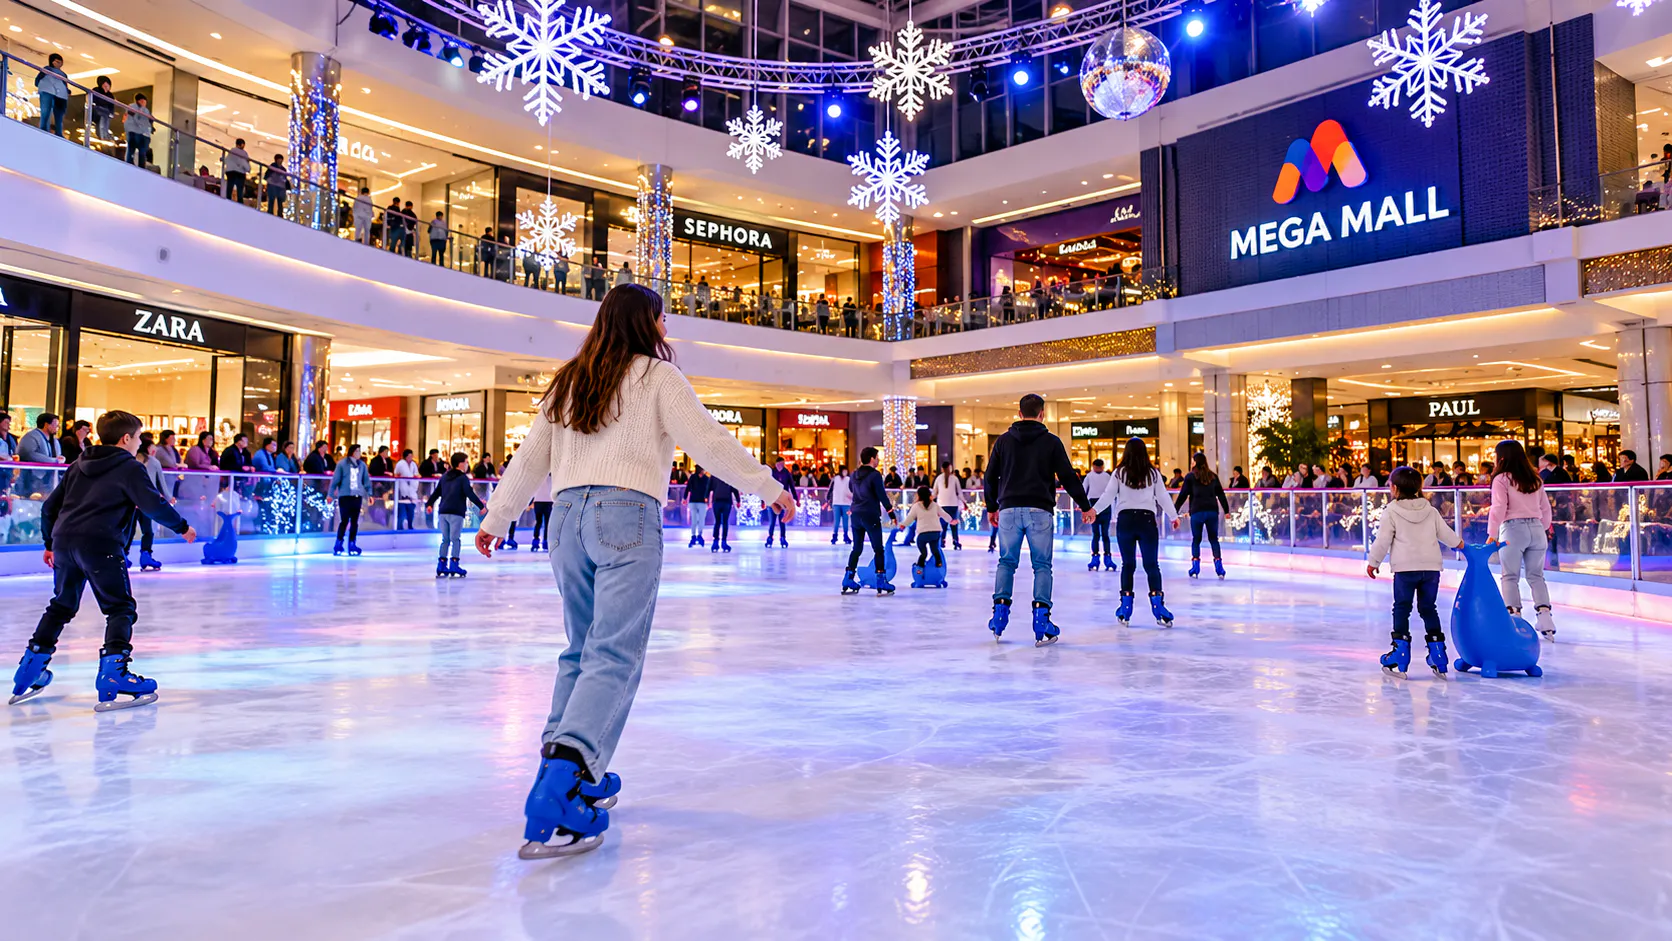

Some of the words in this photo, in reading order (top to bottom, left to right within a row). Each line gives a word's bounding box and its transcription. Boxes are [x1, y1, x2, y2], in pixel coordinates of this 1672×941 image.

[684, 217, 773, 249] SEPHORA
[1230, 211, 1332, 260] MEGA
[1341, 186, 1450, 238] MALL
[132, 309, 205, 343] ZARA
[1428, 400, 1481, 417] PAUL
